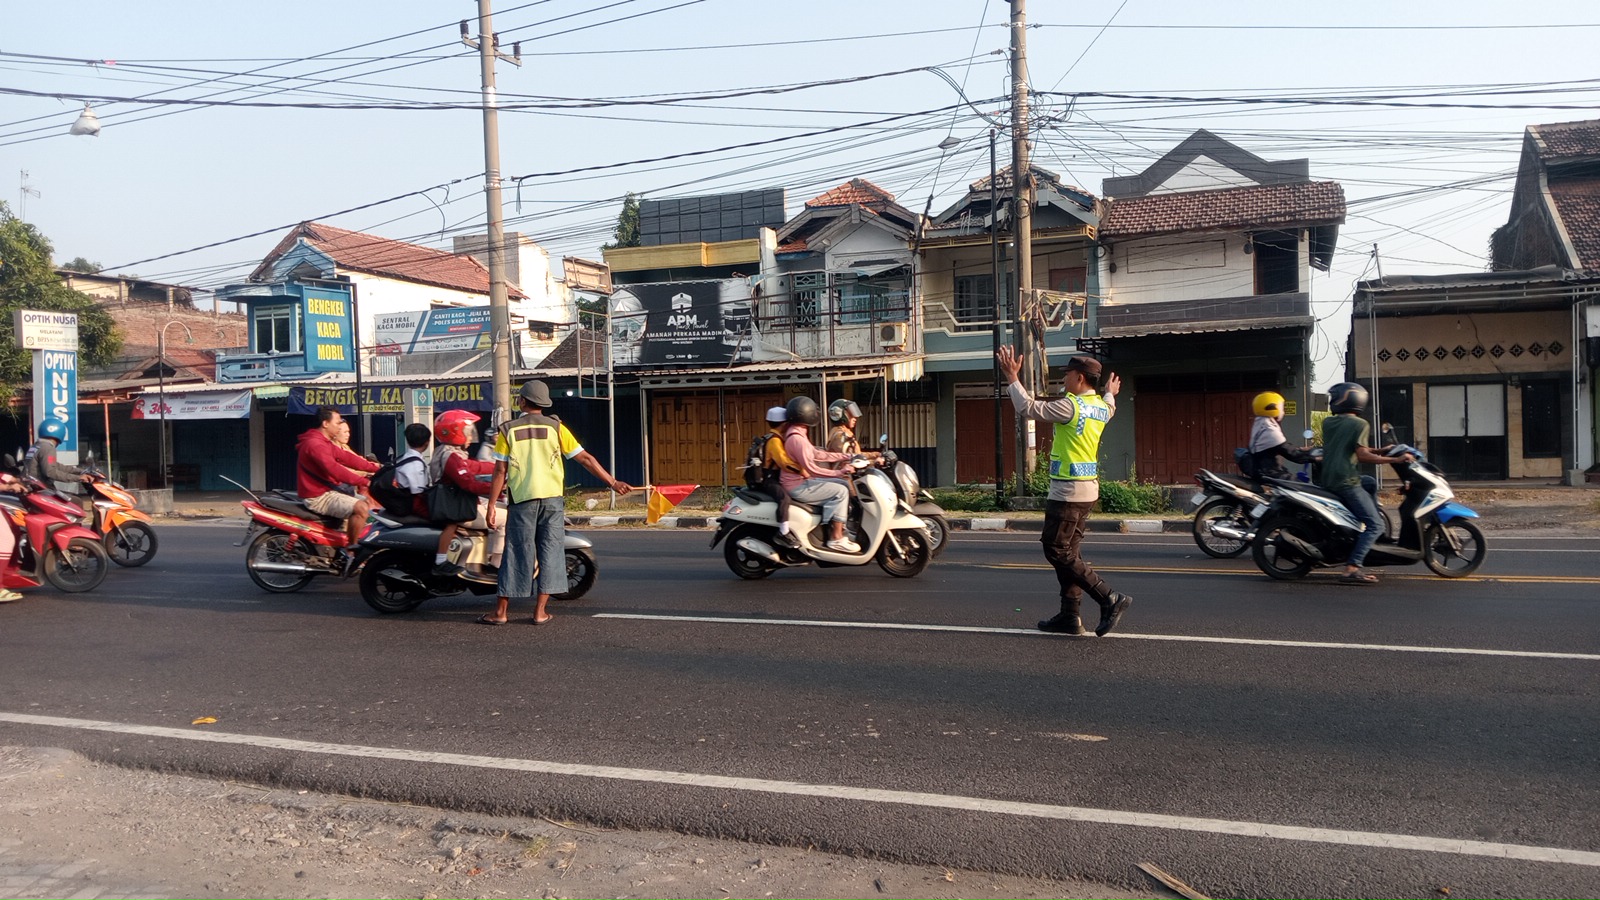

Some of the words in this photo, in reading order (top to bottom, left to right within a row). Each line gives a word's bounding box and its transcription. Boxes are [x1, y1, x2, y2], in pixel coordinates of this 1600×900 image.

[308, 298, 345, 316] BENGKEL
[24, 314, 50, 324] OPTIK
[53, 315, 76, 325] NUSA
[382, 316, 409, 324] SENTRAL
[395, 321, 416, 329] MOBIL
[667, 314, 697, 326] APM
[316, 322, 341, 338] KACA
[317, 344, 345, 360] MOBIL
[45, 352, 75, 370] OPTIK
[305, 388, 374, 405] BENGKEL
[380, 387, 402, 404] KA
[431, 384, 484, 402] MOBIL
